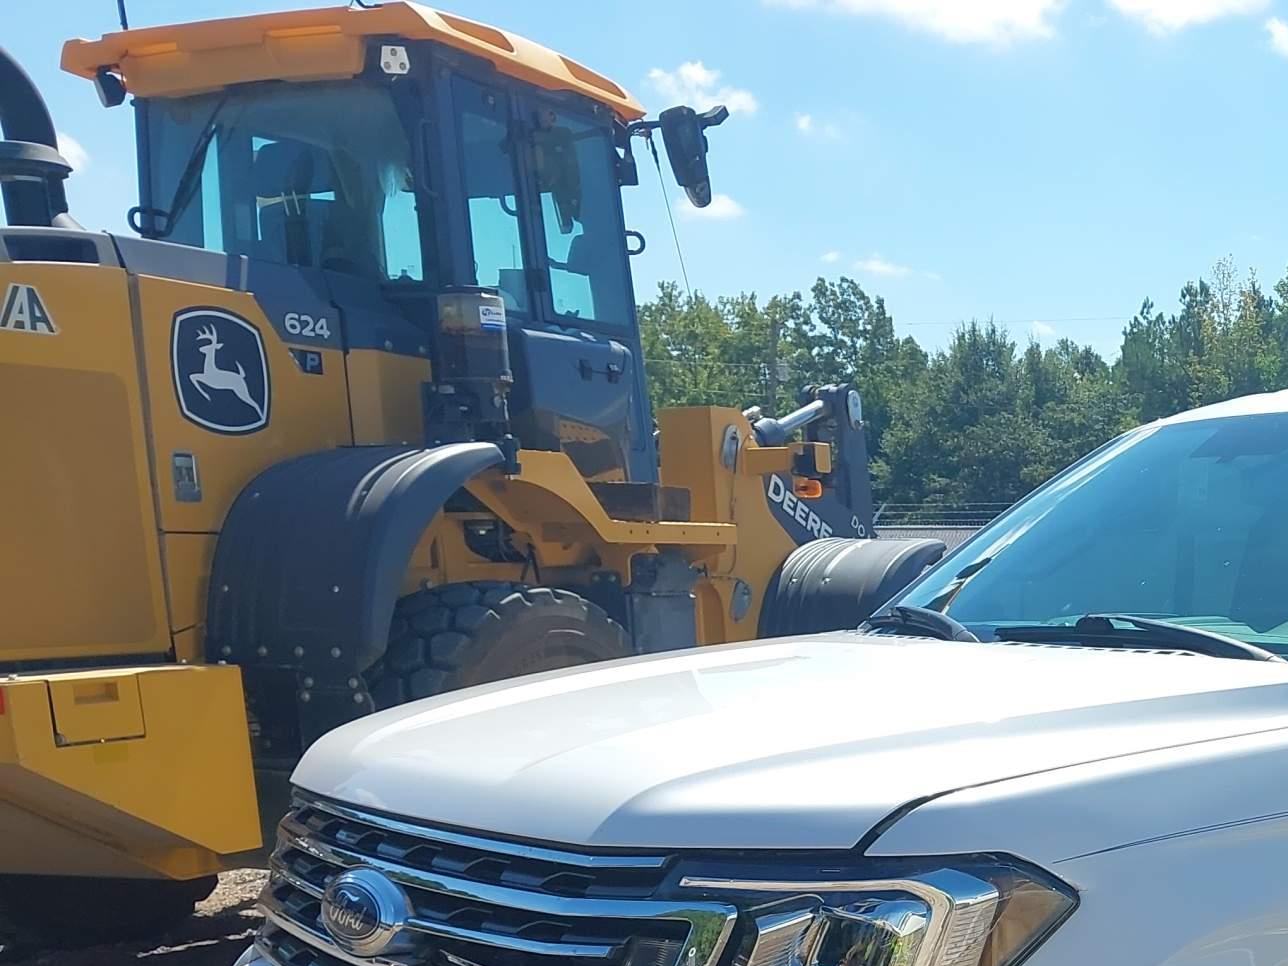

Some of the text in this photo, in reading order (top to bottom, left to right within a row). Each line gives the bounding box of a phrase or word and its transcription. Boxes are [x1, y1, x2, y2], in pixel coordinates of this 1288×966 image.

[284, 311, 331, 339] 624
[767, 473, 833, 538] DEERE
[329, 889, 368, 931] Ford
